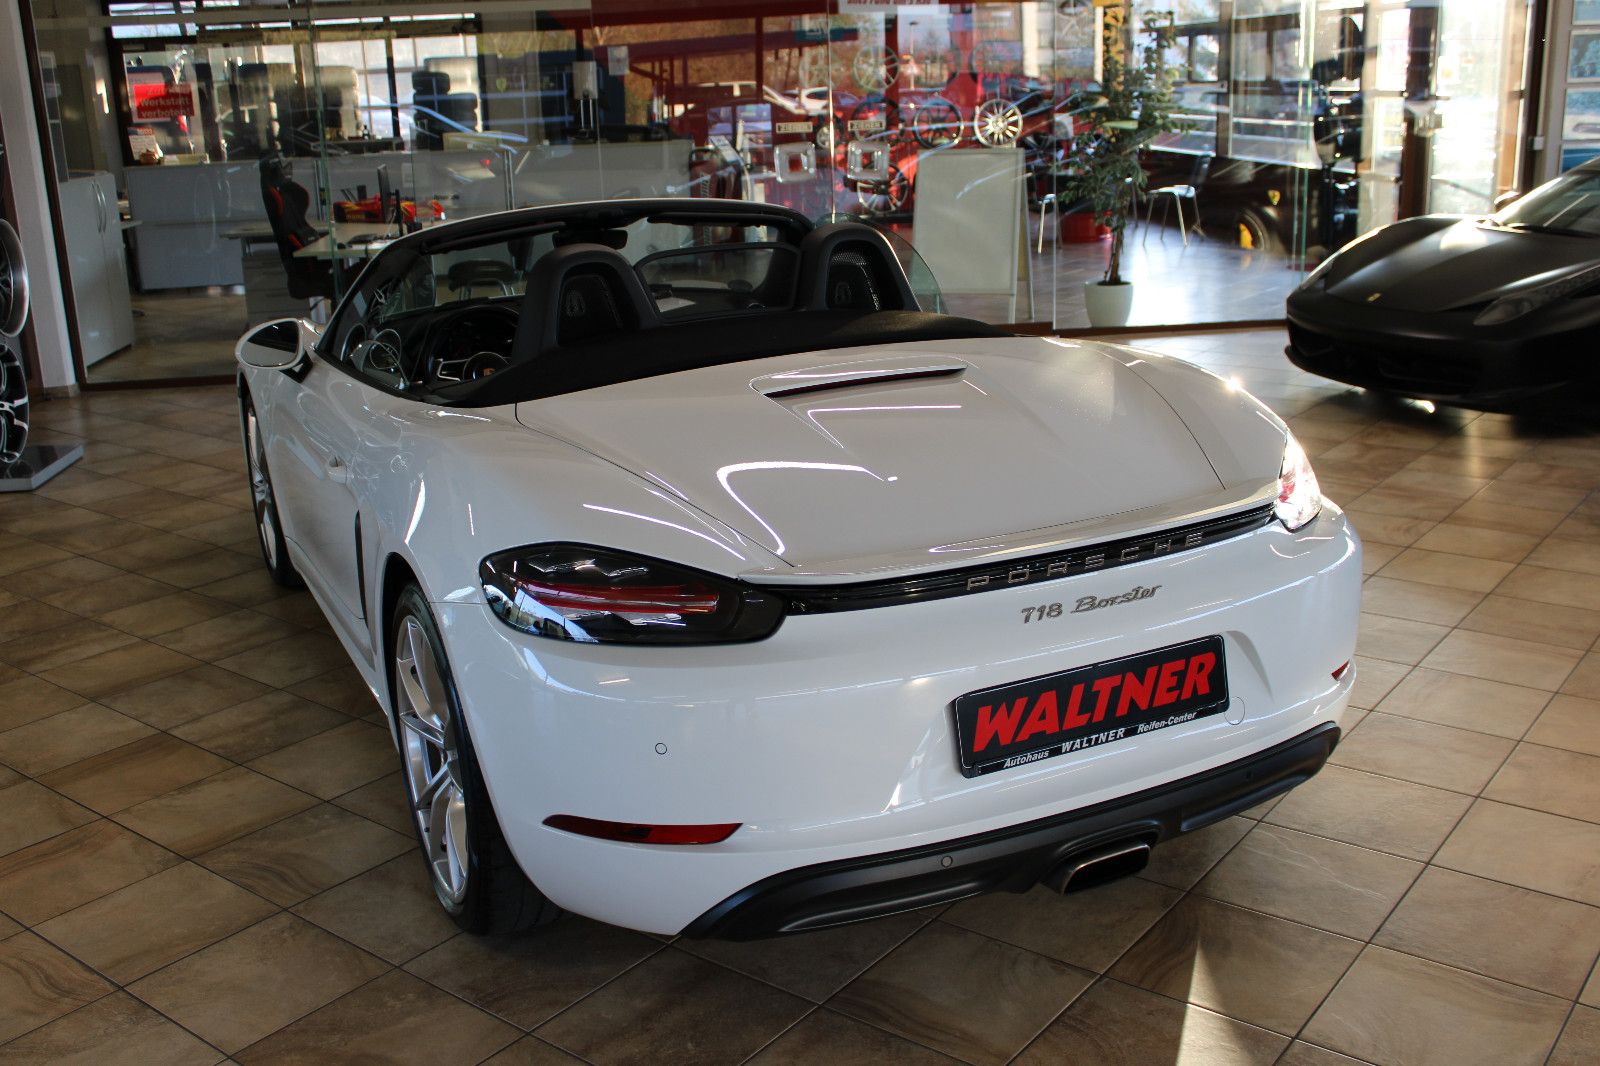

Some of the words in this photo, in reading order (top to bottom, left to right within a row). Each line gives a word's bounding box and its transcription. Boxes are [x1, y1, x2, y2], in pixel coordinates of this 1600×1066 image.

[967, 531, 1203, 590] PORSCHE
[1021, 602, 1063, 624] 718
[1070, 585, 1163, 614] Boxster
[973, 651, 1217, 753] WALTNER
[1003, 749, 1050, 769] Autohaus
[1061, 728, 1126, 754] WALTNER
[1137, 710, 1199, 734] Reifen-Center
